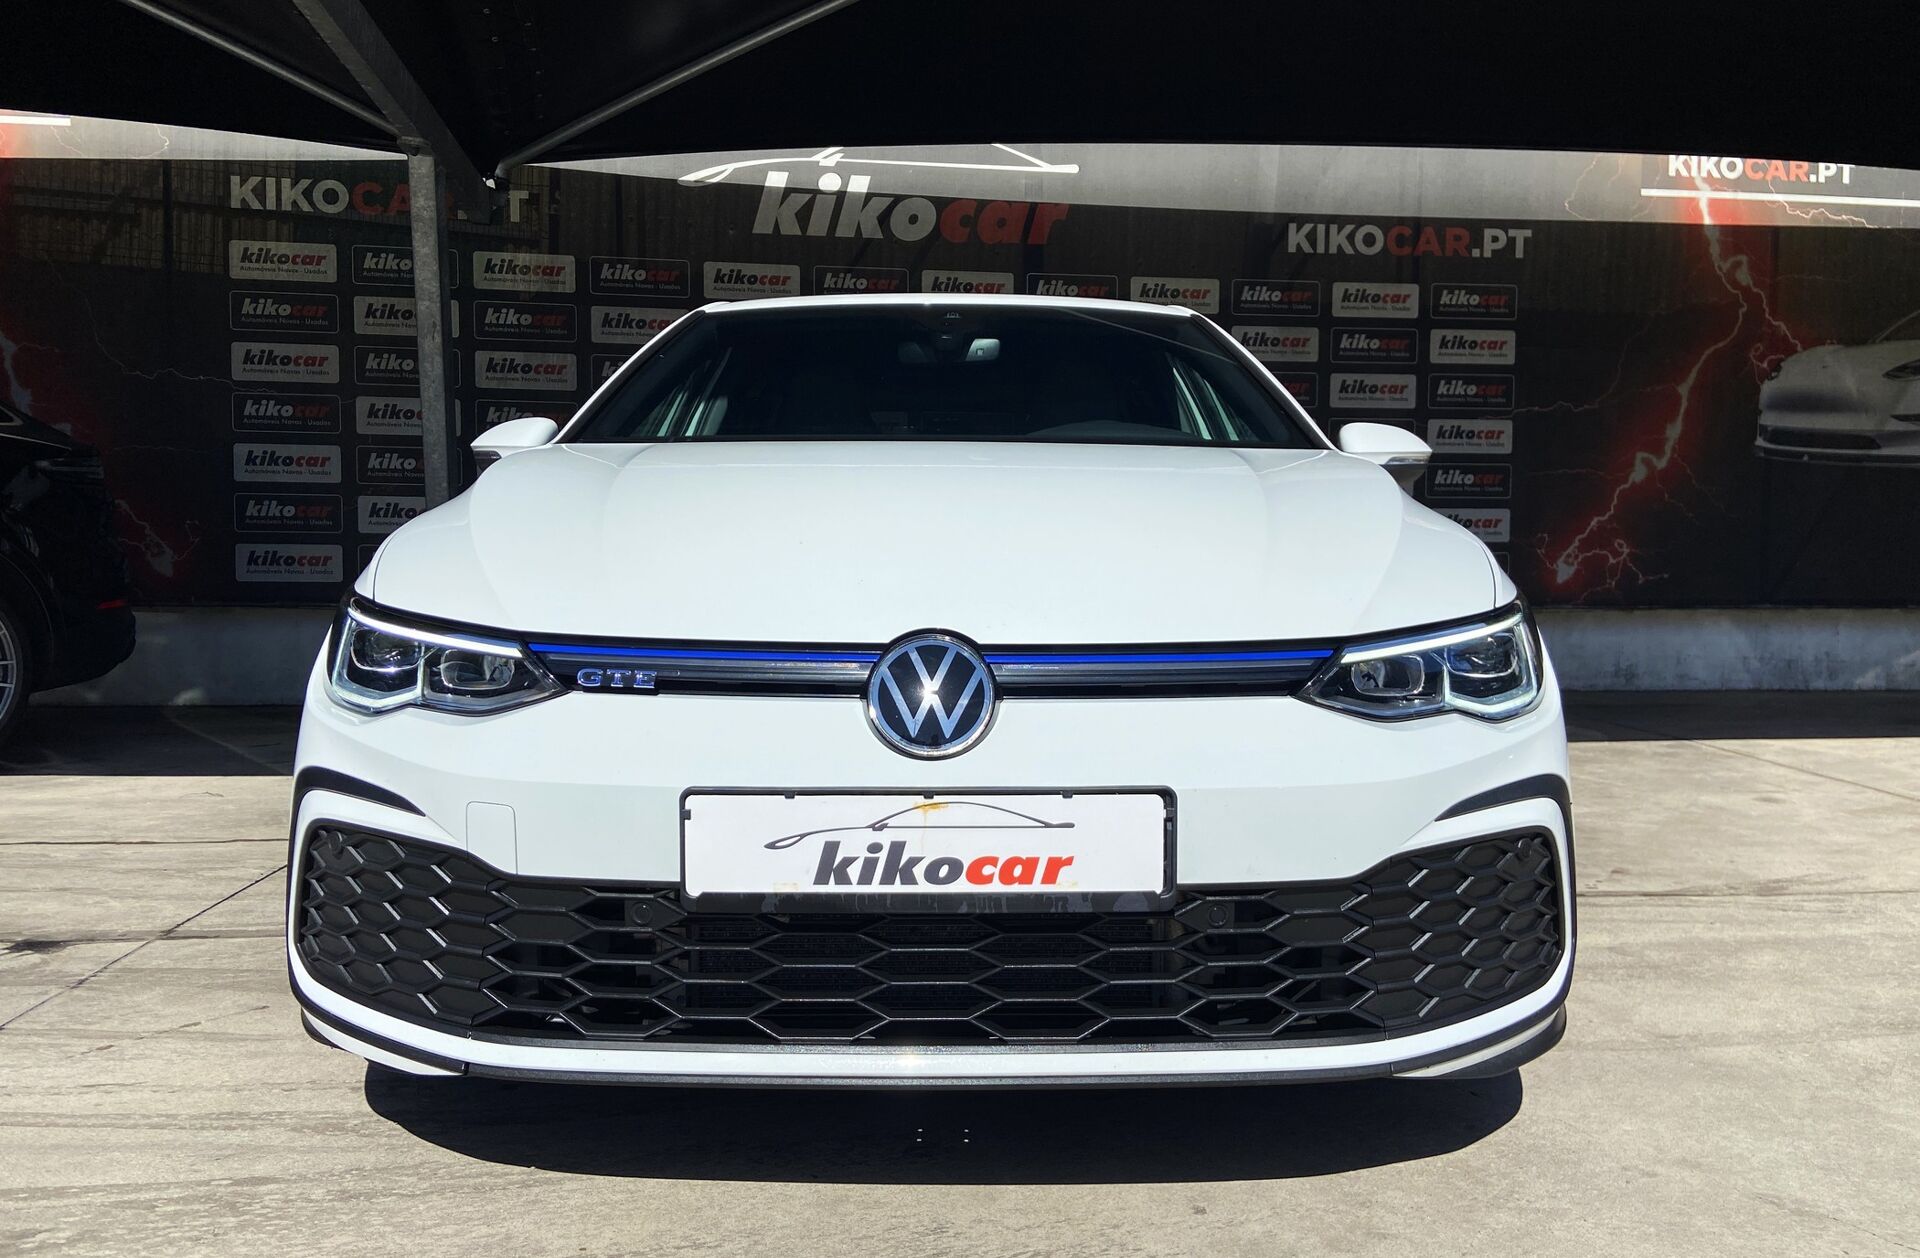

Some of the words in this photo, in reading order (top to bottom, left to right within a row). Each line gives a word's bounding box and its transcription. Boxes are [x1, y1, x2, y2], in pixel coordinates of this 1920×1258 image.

[1667, 154, 1855, 184] KIKOCAR.PT
[752, 171, 1070, 245] kikocar
[1288, 222, 1532, 258] KIKOCAR.PT
[240, 247, 326, 266] kikocar
[484, 258, 565, 277] kikocar
[600, 263, 681, 281] kikocar
[714, 268, 792, 286] kikocar
[824, 272, 899, 290] kikocar
[931, 276, 1005, 293] kikocar
[1037, 280, 1110, 297] kikocar
[1140, 283, 1211, 300] kikocar
[1241, 286, 1312, 302] kikocar
[1341, 288, 1411, 304] kikocar
[1440, 289, 1508, 306] kikocar
[242, 298, 328, 317] kikocar
[485, 307, 567, 326] kikocar
[1240, 332, 1311, 347] kikocar
[1340, 333, 1409, 350] kikocar
[1439, 335, 1507, 350] kikocar
[243, 349, 329, 367] kikocar
[486, 357, 568, 375] kikocar
[1339, 380, 1408, 394] kikocar
[1437, 380, 1507, 396] kikocar
[1436, 425, 1504, 440] kikocar
[244, 450, 331, 467] kikocar
[1434, 469, 1504, 486] kikocar
[247, 550, 332, 567] kikocar
[576, 667, 659, 689] GTE
[813, 840, 1075, 886] kikocar
